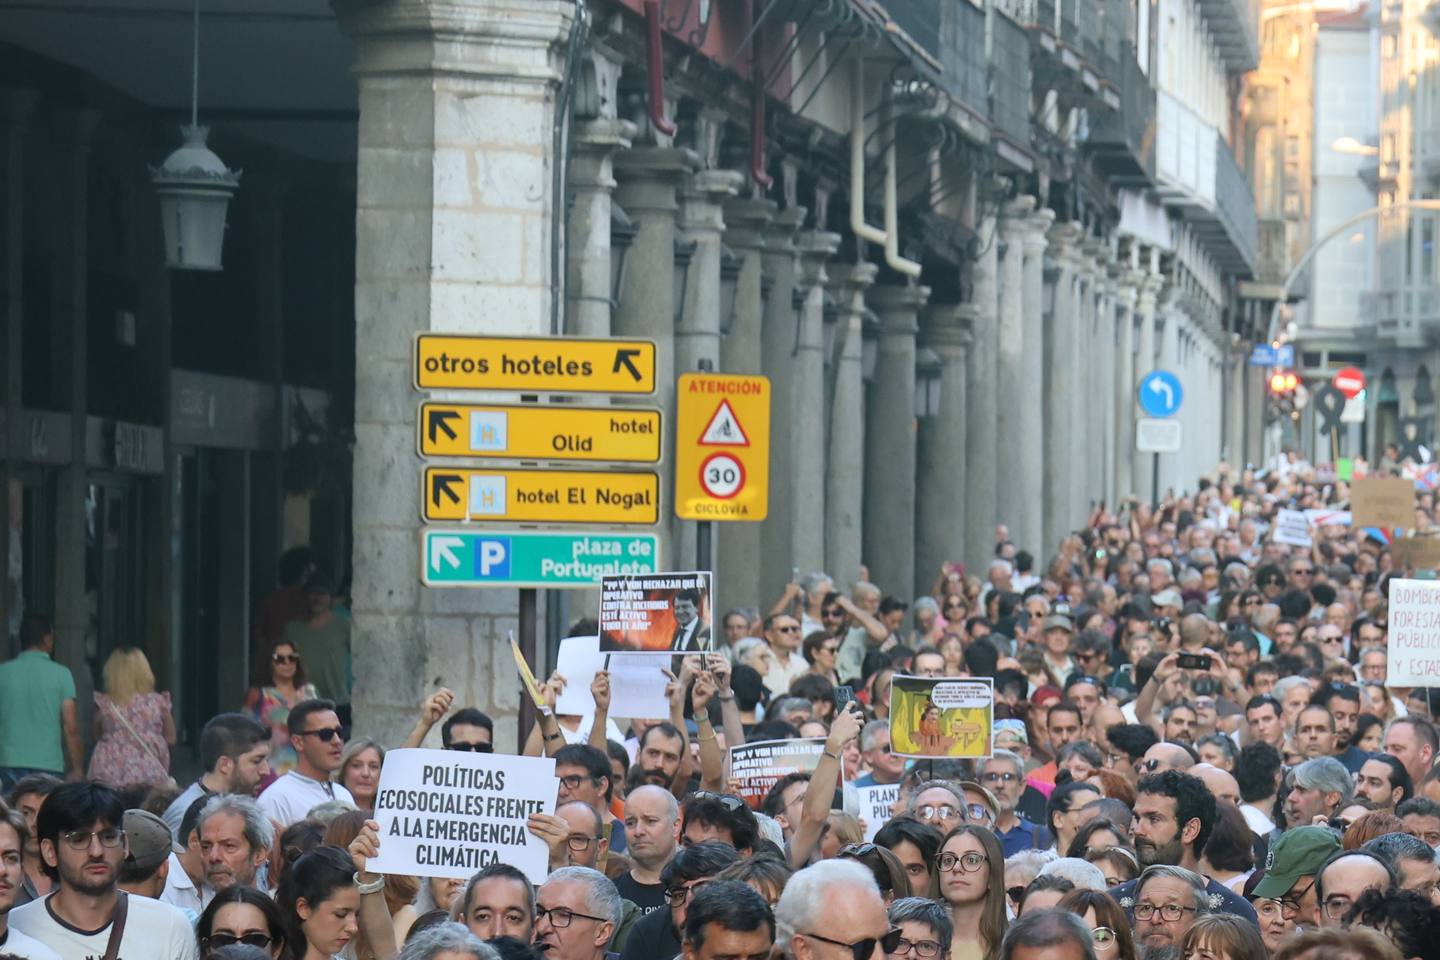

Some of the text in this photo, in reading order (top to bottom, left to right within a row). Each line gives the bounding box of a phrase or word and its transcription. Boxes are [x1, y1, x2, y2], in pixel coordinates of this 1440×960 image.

[424, 353, 593, 376] otros hoteles
[689, 379, 762, 396] ATENCIÓN
[610, 418, 654, 434] hotel
[552, 434, 593, 453] Olid
[709, 468, 736, 485] 30
[516, 488, 652, 509] hotel El Nogal
[694, 503, 749, 515] CICLOVÍA
[480, 540, 506, 576] P
[572, 537, 652, 559] plaza de
[541, 558, 652, 581] Portugalete
[1394, 660, 1403, 675] Y
[421, 764, 505, 791] POLÍTICAS
[377, 789, 545, 819] ECOSOCIALES FRENTE
[389, 816, 528, 846] A LA EMERGENCIA
[415, 843, 500, 869] CLIMÁTICA
